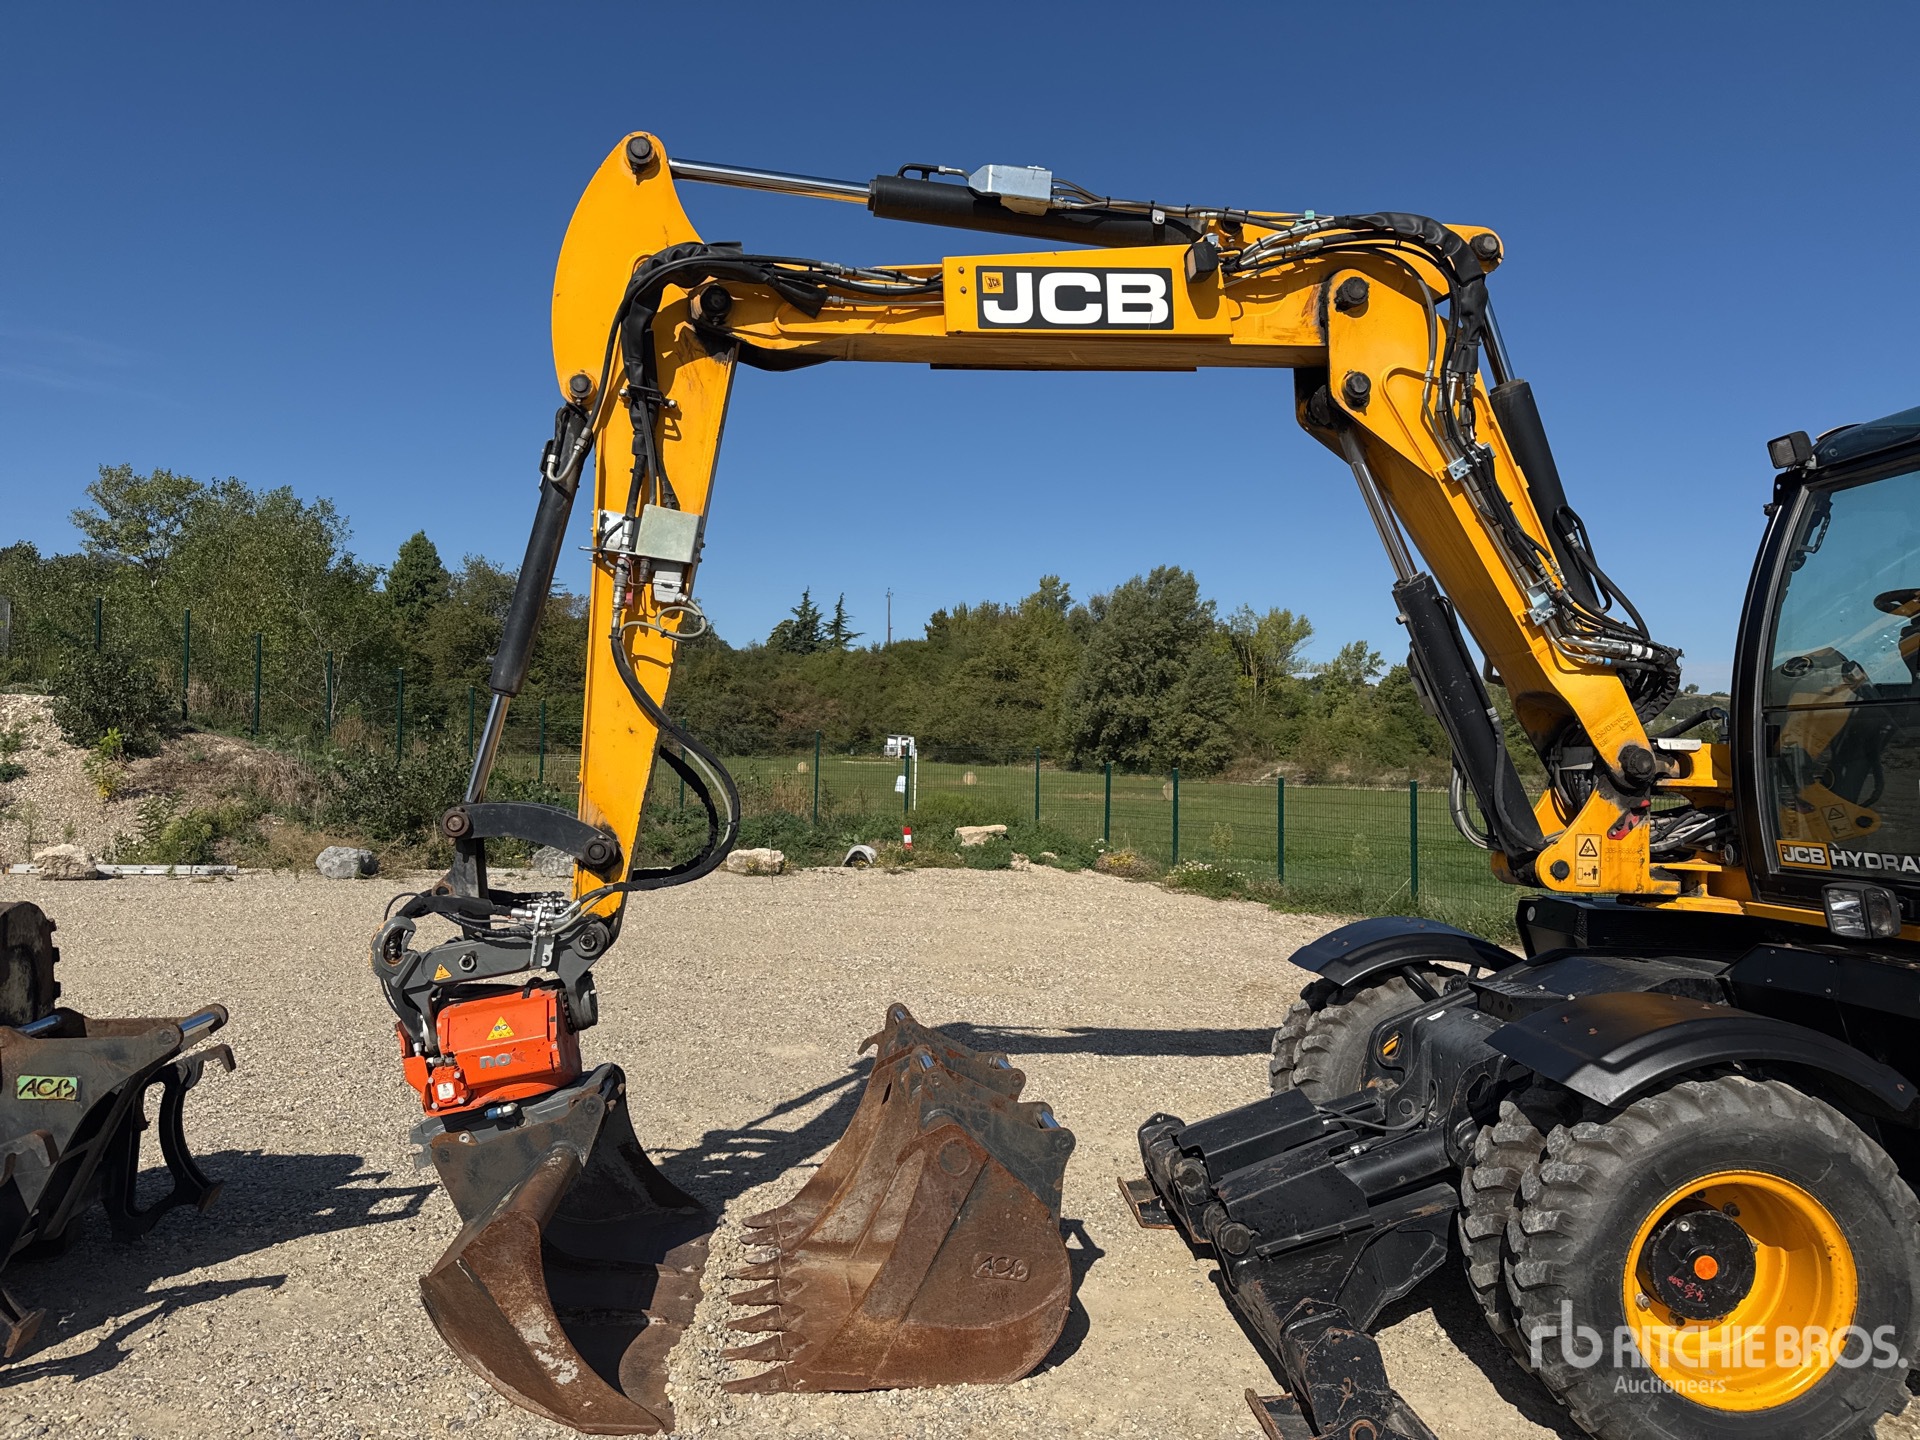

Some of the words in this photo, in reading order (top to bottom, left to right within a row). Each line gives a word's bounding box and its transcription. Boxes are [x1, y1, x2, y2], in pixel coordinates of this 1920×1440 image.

[983, 272, 1169, 324] JCB
[1784, 846, 1826, 864] JCB
[1830, 850, 1920, 873] HYDRA
[18, 1078, 75, 1097] ACB
